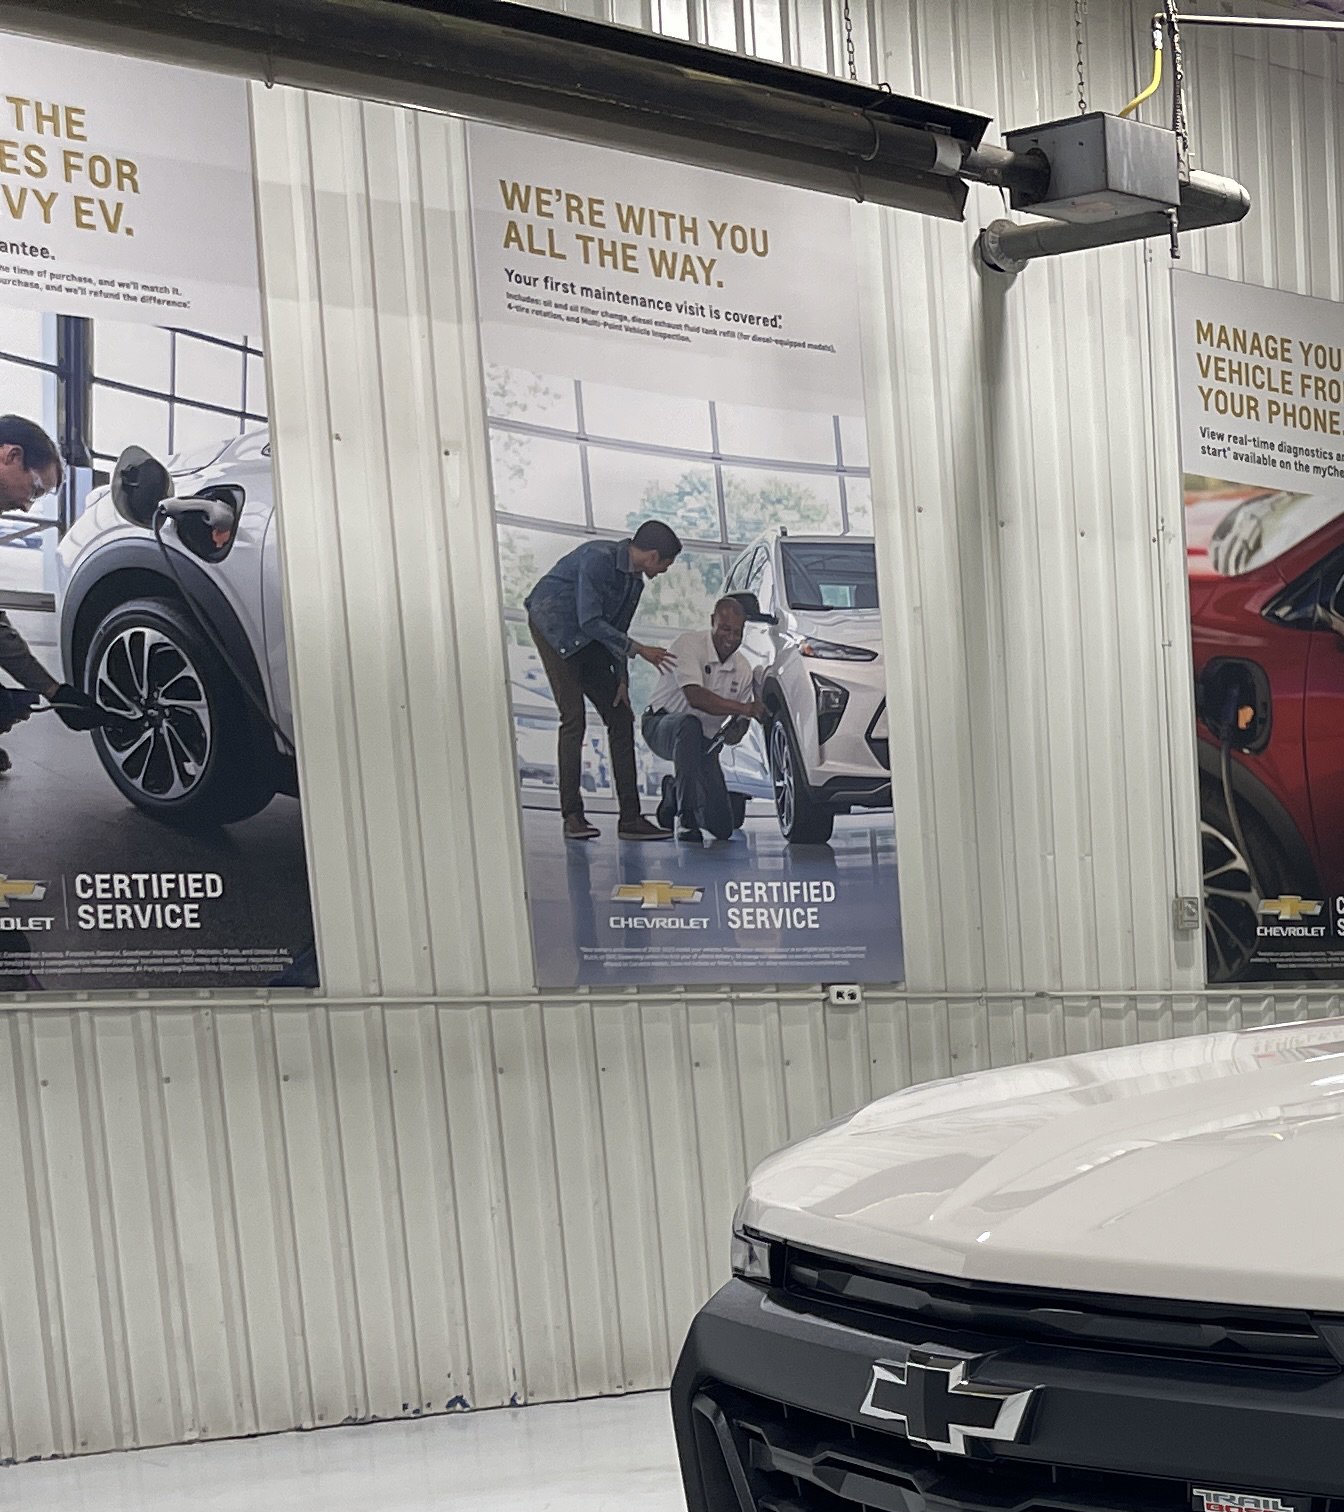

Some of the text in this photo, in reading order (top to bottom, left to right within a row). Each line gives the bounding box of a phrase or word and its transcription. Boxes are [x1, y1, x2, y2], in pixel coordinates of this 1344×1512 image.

[6, 96, 87, 142] THE
[63, 150, 140, 194] FOR
[74, 196, 134, 236] EV.
[499, 179, 769, 257] WE'RE WITH YOU
[503, 221, 724, 288] ALL THE WAY.
[13, 266, 34, 276] time
[37, 270, 47, 279] of
[50, 272, 96, 286] purchase,
[99, 279, 115, 287] and
[45, 284, 62, 292] and
[65, 286, 86, 296] we'll
[89, 289, 120, 300] refund
[123, 294, 137, 302] the
[505, 267, 539, 288] Your
[543, 275, 577, 295] first
[581, 286, 672, 312] maintenance
[676, 300, 705, 317] visit
[709, 305, 720, 320] is
[554, 301, 568, 311] and
[566, 315, 580, 324] and
[1196, 319, 1292, 363] MANAGE
[1196, 352, 1293, 395] VEHICLE
[1198, 385, 1260, 422] YOUR
[1200, 426, 1224, 442] View
[1227, 434, 1275, 451] real-time
[1278, 441, 1334, 461] diagnostics
[1232, 451, 1276, 468] available
[1279, 459, 1291, 470] on
[1294, 460, 1310, 473] the
[74, 873, 223, 899] CERTIFIED
[725, 881, 836, 903] CERTIFIED
[78, 904, 201, 930] SERVICE
[609, 916, 710, 930] CHEVROLET
[727, 907, 819, 930] SERVICE
[1256, 926, 1325, 937] CHEVROLET
